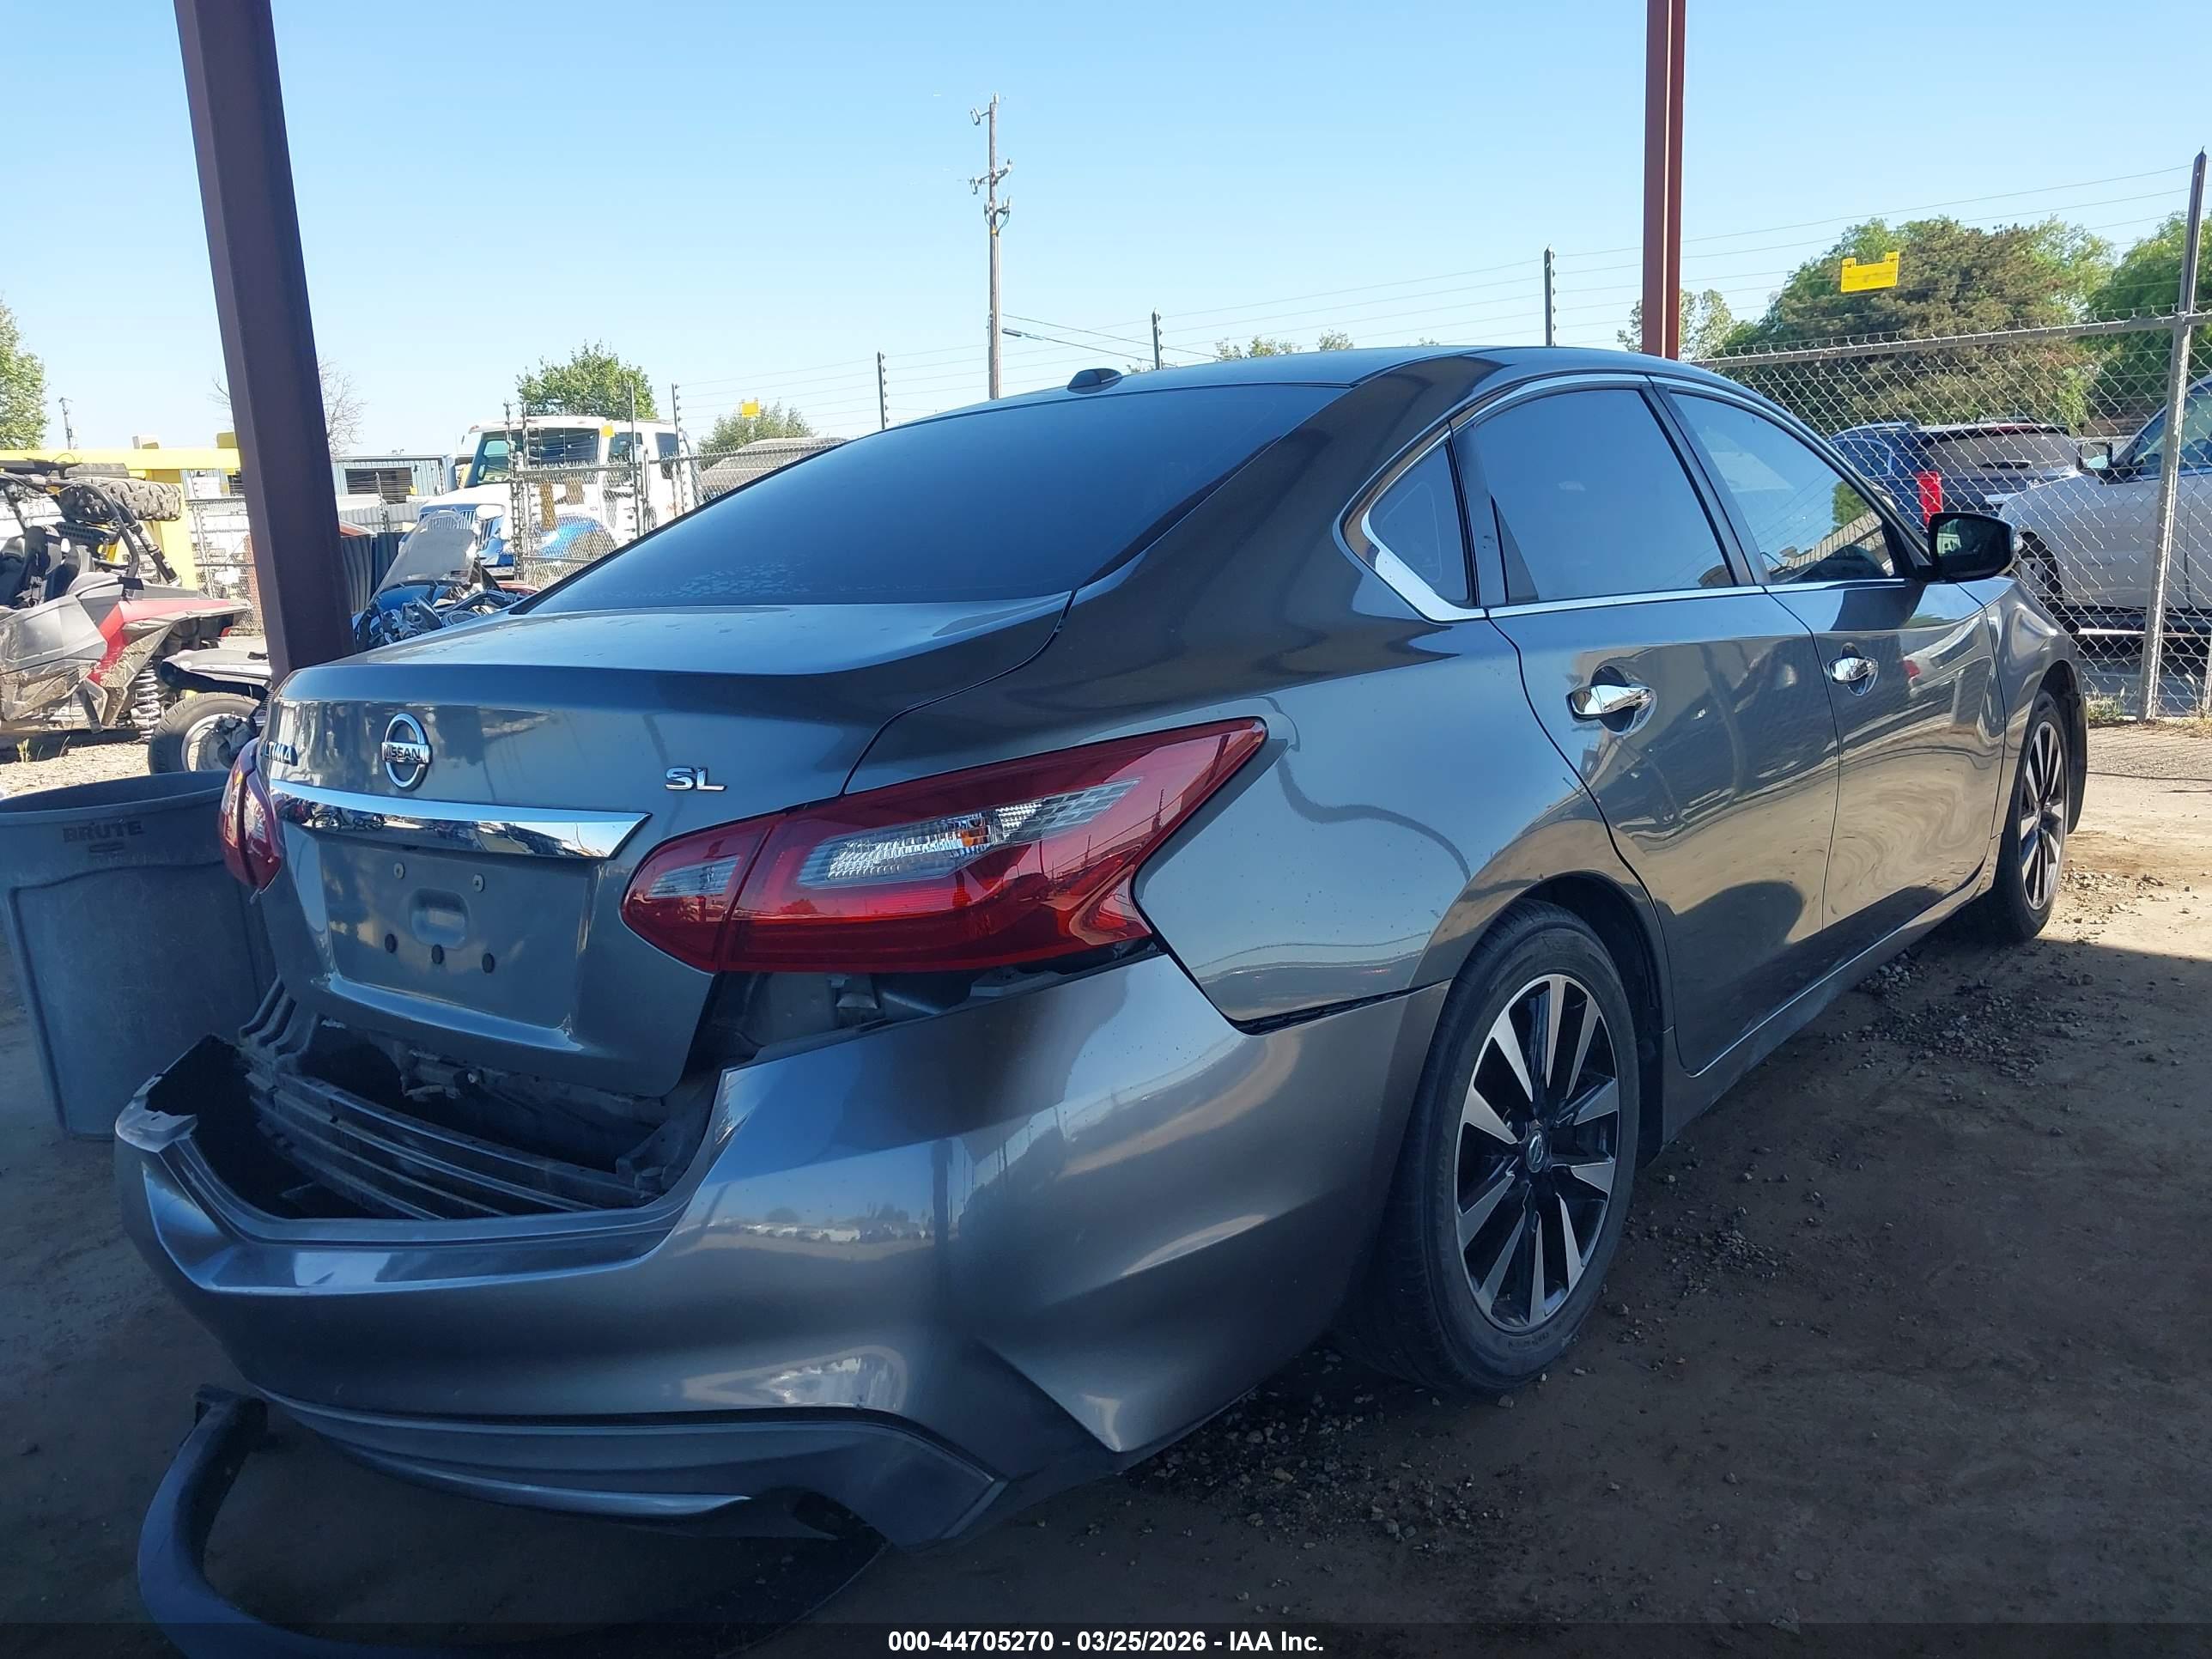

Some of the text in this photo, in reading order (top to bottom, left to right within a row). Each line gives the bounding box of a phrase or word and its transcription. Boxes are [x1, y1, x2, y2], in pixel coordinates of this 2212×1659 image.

[383, 744, 422, 762] NISSAN
[665, 767, 727, 792] SL
[62, 820, 145, 842] BRUTE
